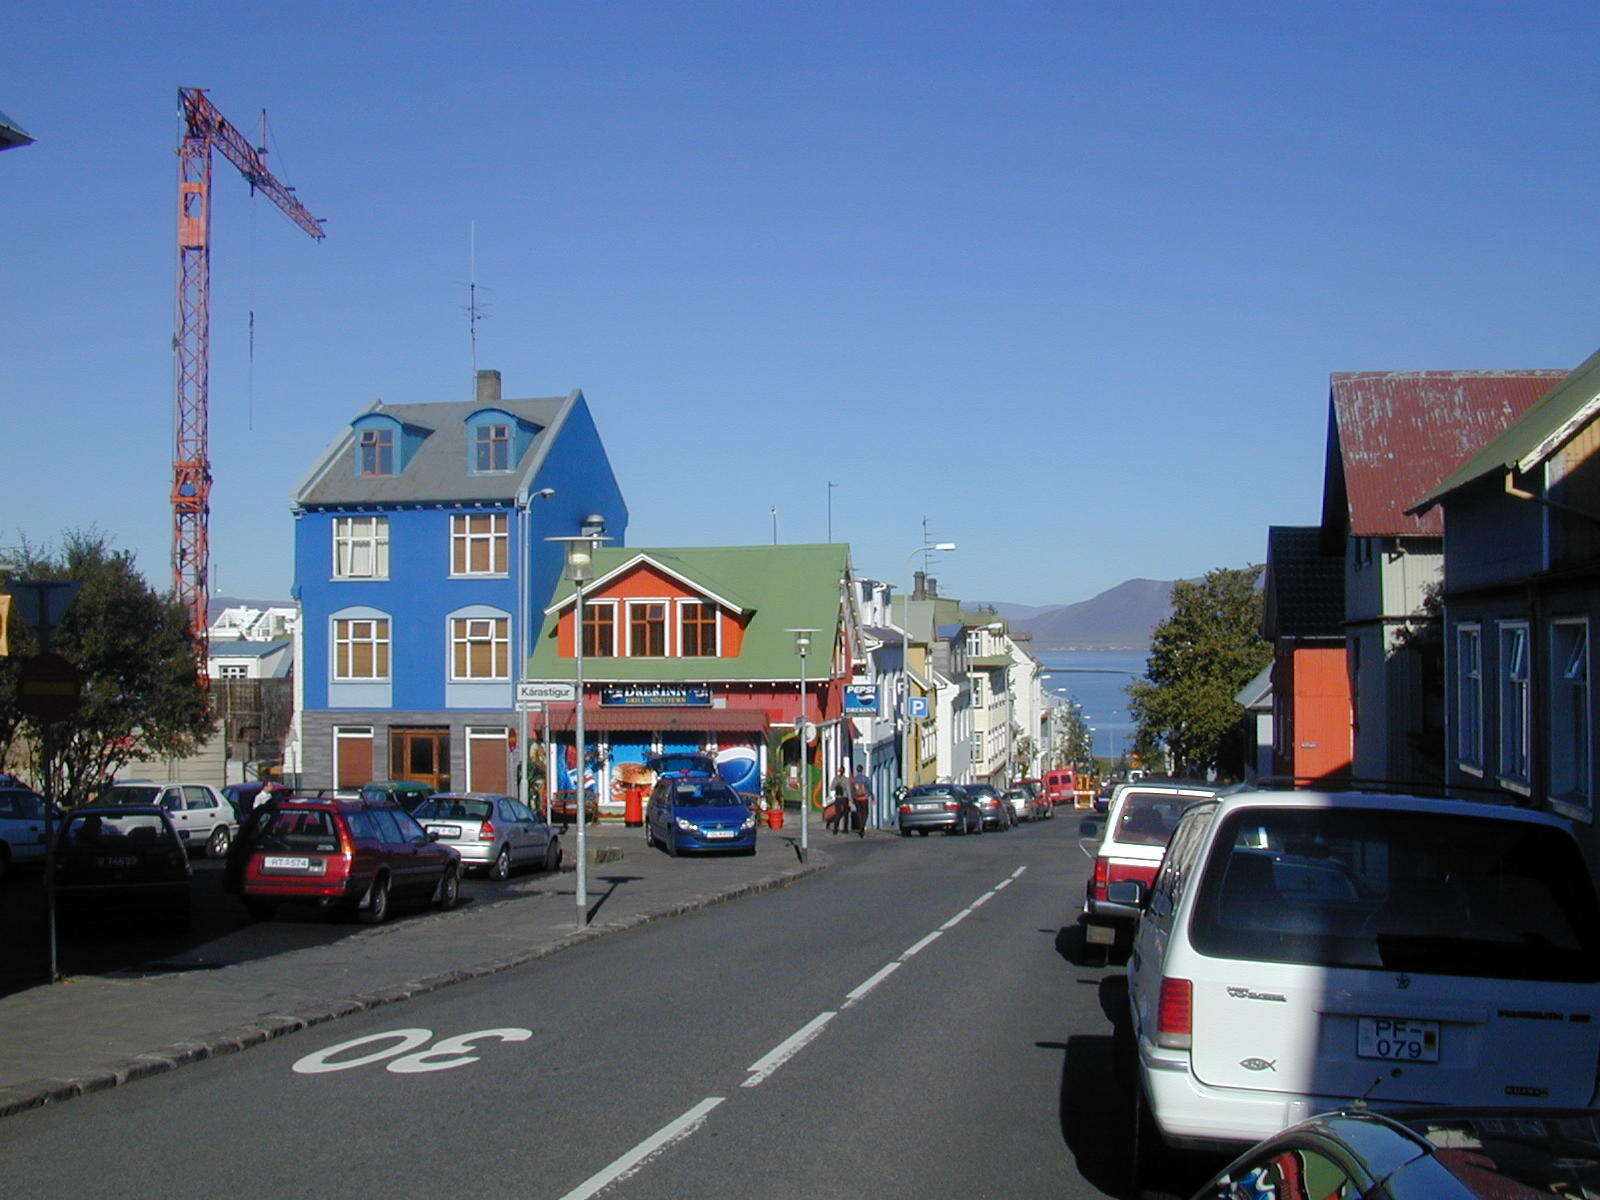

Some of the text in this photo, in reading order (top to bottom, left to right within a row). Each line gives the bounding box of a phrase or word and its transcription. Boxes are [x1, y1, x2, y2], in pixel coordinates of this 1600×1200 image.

[847, 686, 876, 694] PEPSI
[913, 700, 925, 715] P
[1377, 1039, 1422, 1058] 079
